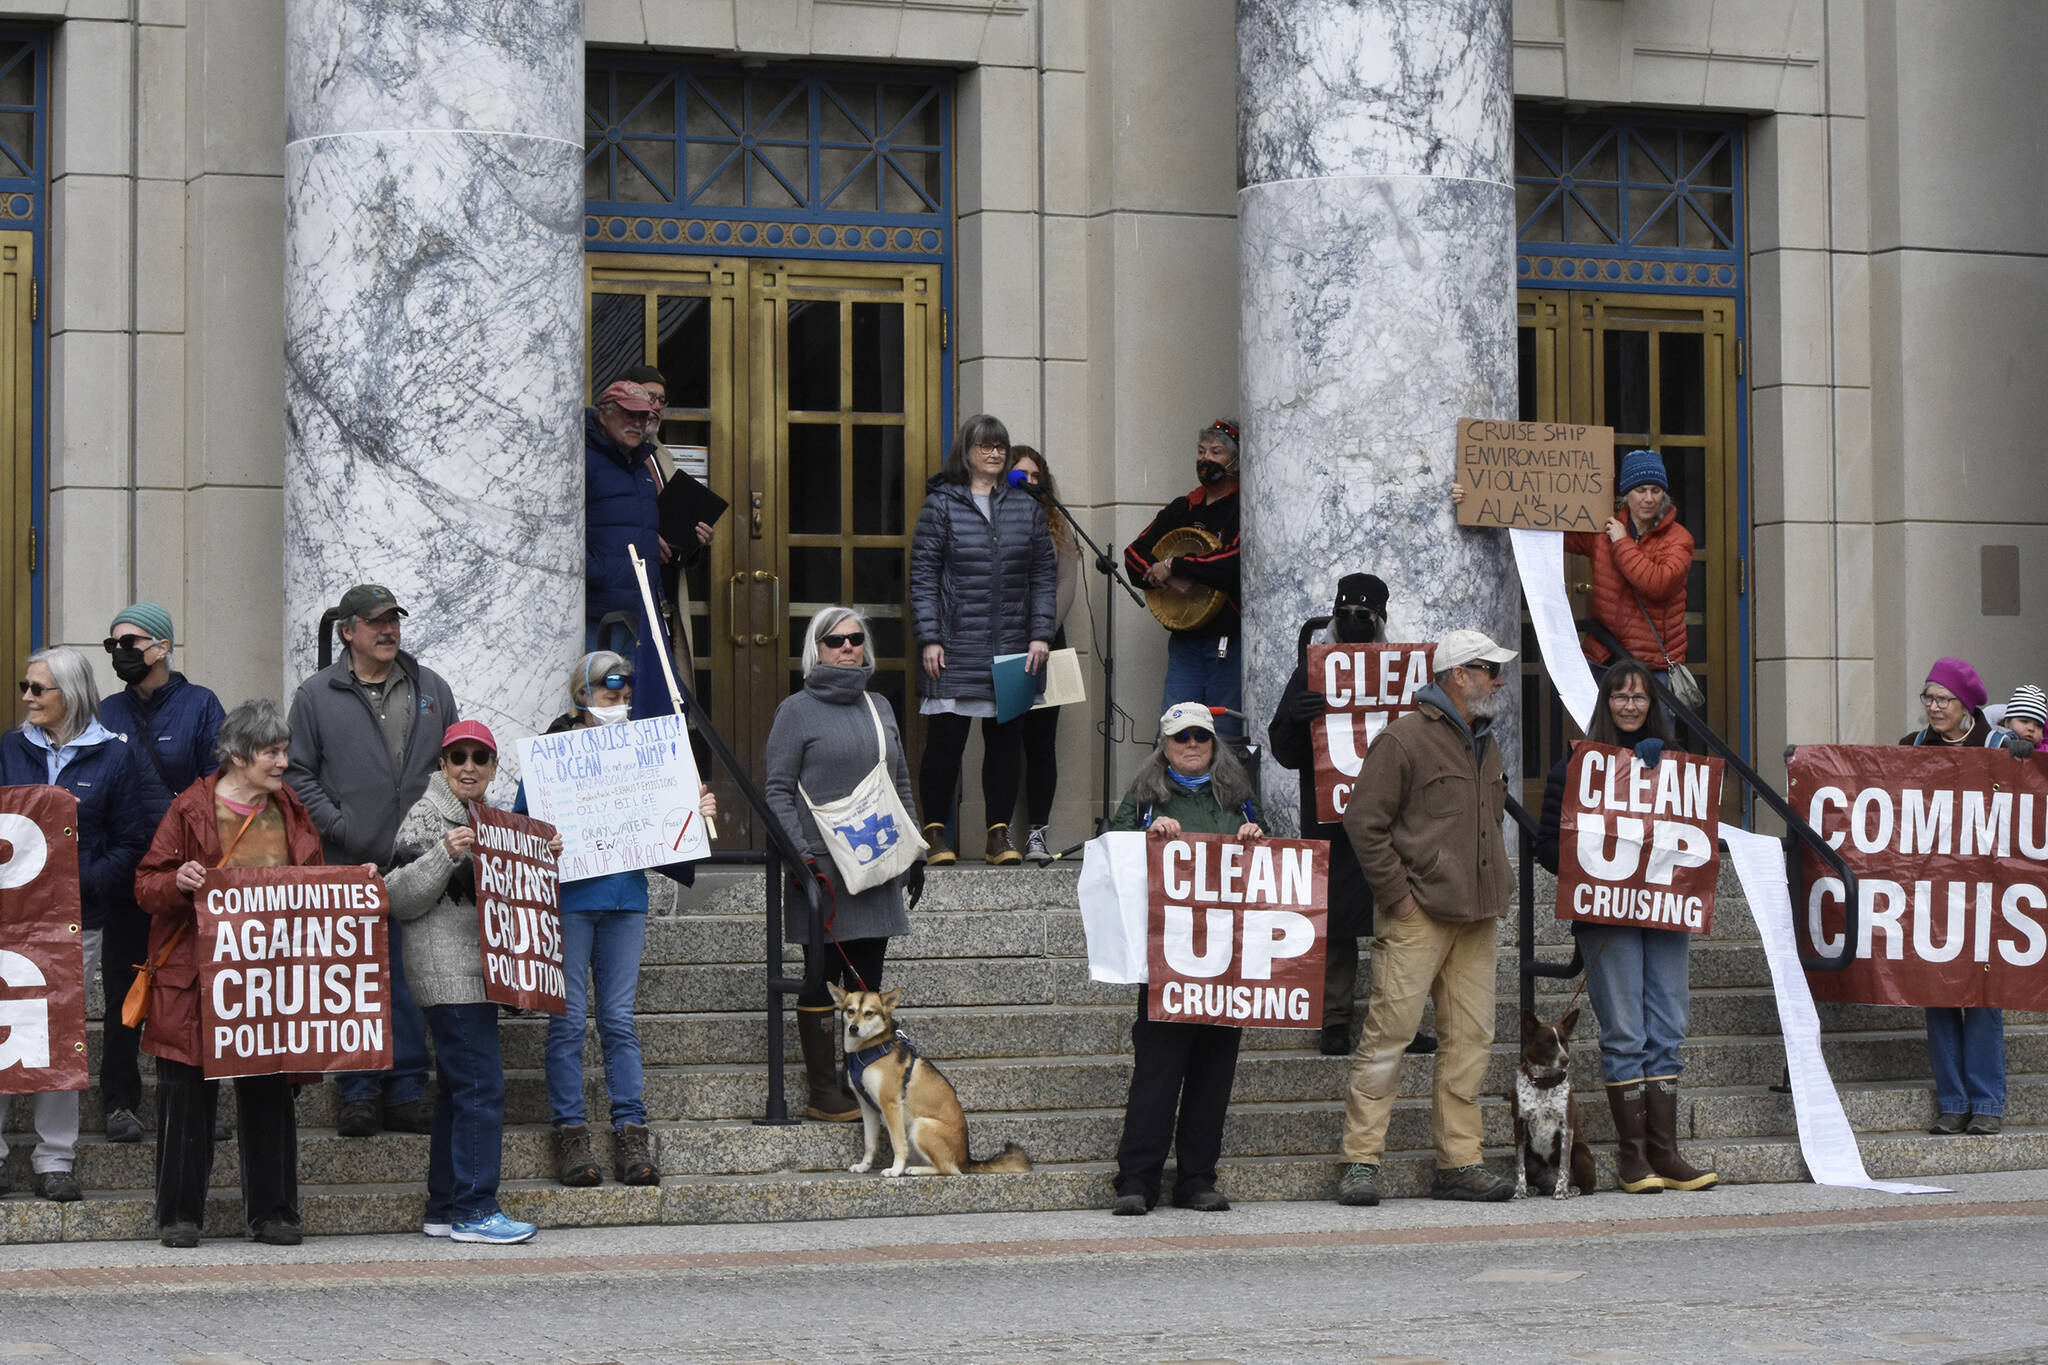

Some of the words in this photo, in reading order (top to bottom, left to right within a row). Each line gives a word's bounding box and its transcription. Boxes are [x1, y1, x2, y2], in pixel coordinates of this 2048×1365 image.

[1466, 420, 1536, 442] CRUISE
[1544, 424, 1586, 442] SHIP
[1465, 445, 1601, 470] ENVIROMENTAL
[1468, 468, 1602, 494] VIOLATIONS
[1525, 494, 1541, 505] IN
[1477, 498, 1597, 530] ALASKA
[1325, 650, 1428, 708] CLEA
[581, 723, 631, 754] CRUISE
[634, 715, 681, 745] SHIPS!
[1325, 711, 1415, 777] U
[556, 753, 602, 782] OCEAN
[575, 773, 631, 791] HAZARDOUS
[1579, 750, 1710, 820] CLEAN
[541, 798, 553, 810] No
[544, 811, 556, 822] No
[576, 799, 608, 815] OILY
[614, 793, 656, 810] BILGE
[476, 821, 555, 865] COMMUNITIES
[585, 834, 639, 854] SEWAGE
[594, 850, 612, 873] UP
[646, 842, 666, 867] ACT
[1577, 812, 1712, 886] UP
[480, 853, 559, 909] AGAINST
[1163, 840, 1313, 905] CLEAN
[207, 884, 381, 915] COMMUNITIES
[1573, 883, 1703, 928] CRUISING
[212, 915, 380, 962] AGAINST
[484, 898, 563, 963] CRUISE
[1808, 876, 2048, 967] CRUIS
[1163, 905, 1316, 980] UP
[212, 963, 381, 1020] CRUISE
[1162, 981, 1310, 1021] CRUISING
[214, 1018, 383, 1059] POLLUTION
